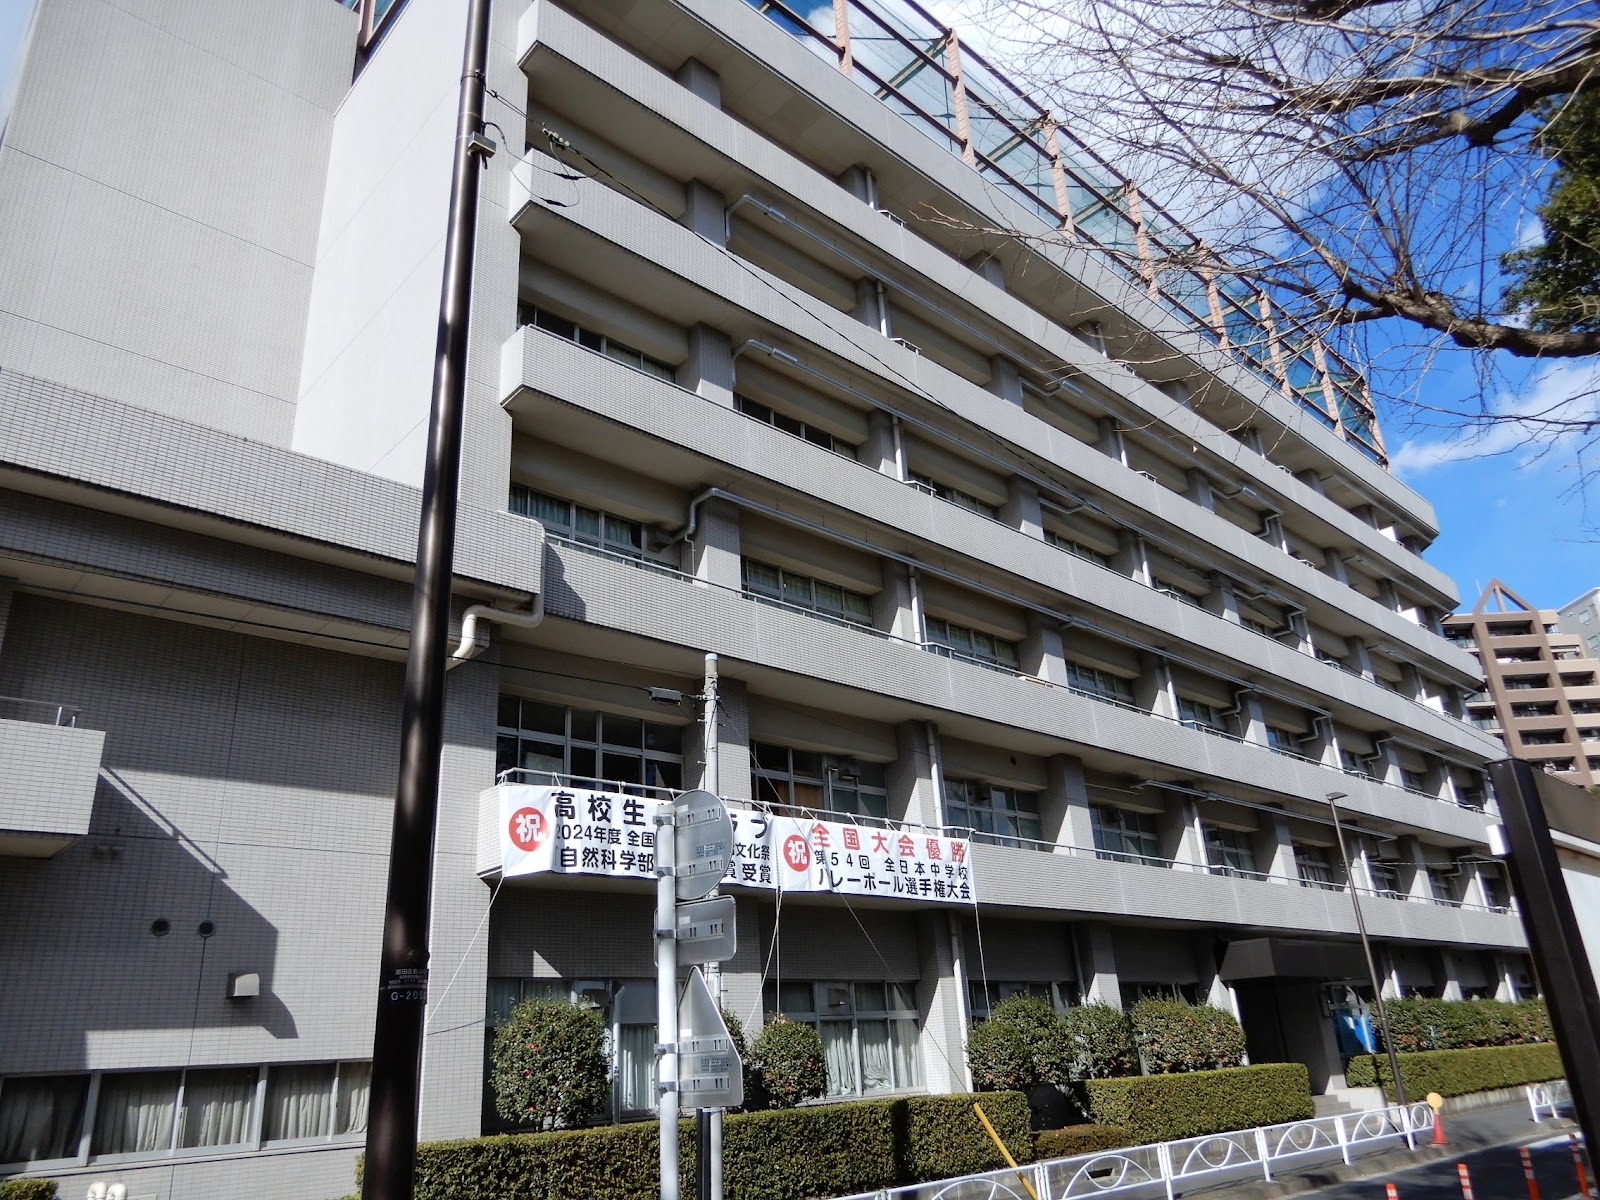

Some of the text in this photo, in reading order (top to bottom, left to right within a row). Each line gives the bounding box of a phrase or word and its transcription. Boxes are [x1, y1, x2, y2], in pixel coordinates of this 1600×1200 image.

[551, 791, 647, 826] 高校生
[515, 813, 549, 844] 祝
[556, 824, 622, 845] 2024年度
[627, 830, 655, 848] 全国
[730, 842, 771, 860] 文化祭
[811, 823, 966, 863] 全国大会優勝
[560, 846, 655, 873] 自然科学部
[787, 840, 808, 865] 祝
[884, 857, 968, 880] 全日本中学校
